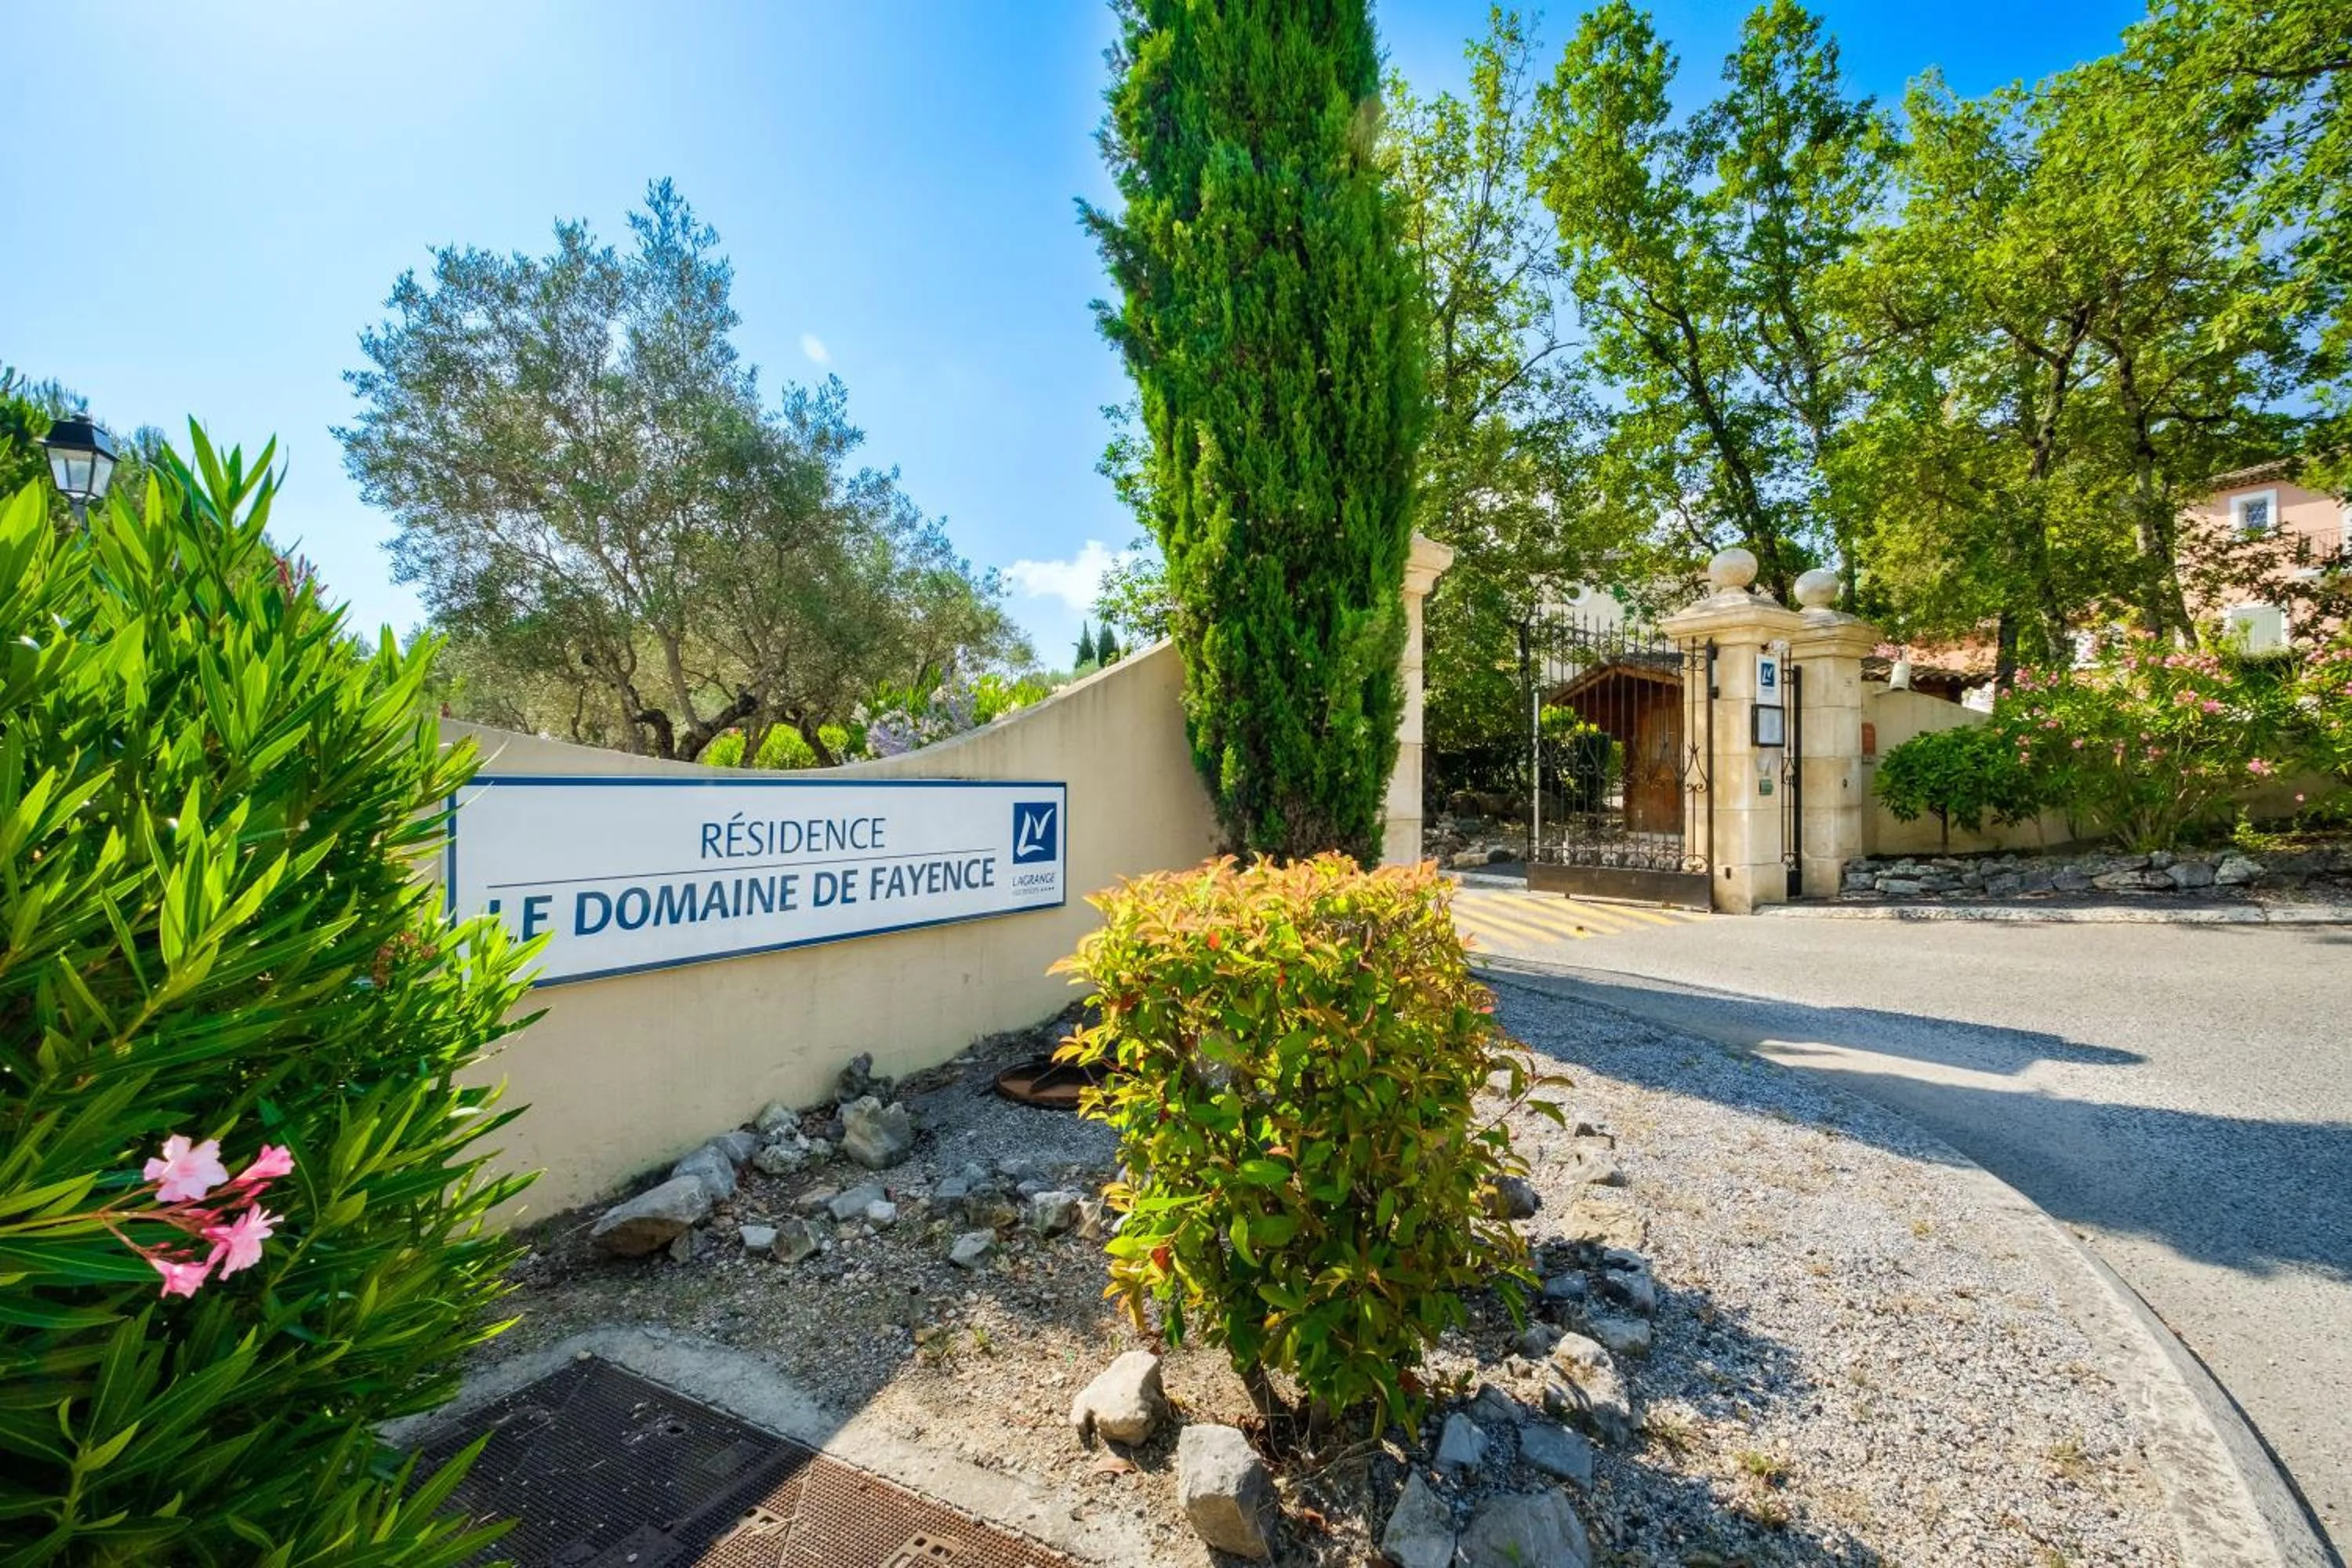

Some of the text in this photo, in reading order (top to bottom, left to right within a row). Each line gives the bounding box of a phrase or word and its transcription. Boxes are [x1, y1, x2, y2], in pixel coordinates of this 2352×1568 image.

[701, 811, 886, 859] RÉSIDENCE
[574, 874, 800, 936] DOMAINE
[813, 869, 858, 907] DE
[869, 858, 996, 901] FAYENCE
